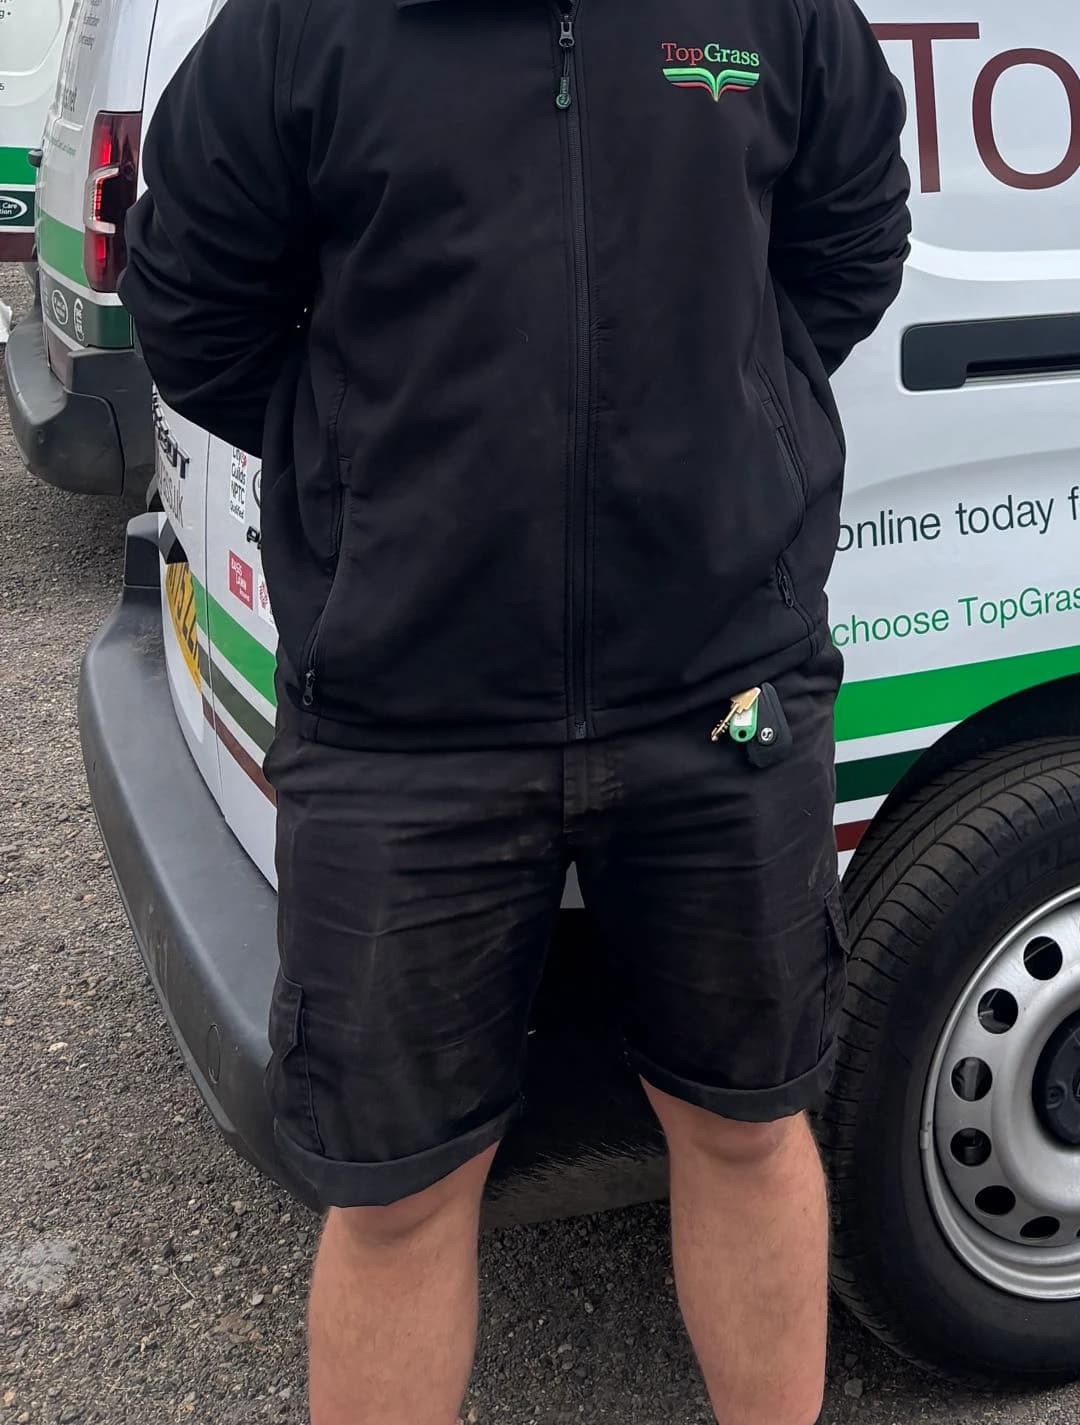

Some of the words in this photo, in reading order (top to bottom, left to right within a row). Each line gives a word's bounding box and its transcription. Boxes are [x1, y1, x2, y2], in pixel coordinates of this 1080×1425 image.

[661, 42, 760, 66] TopGrass
[836, 509, 941, 552] online
[955, 494, 1055, 536] today
[832, 609, 949, 647] choose
